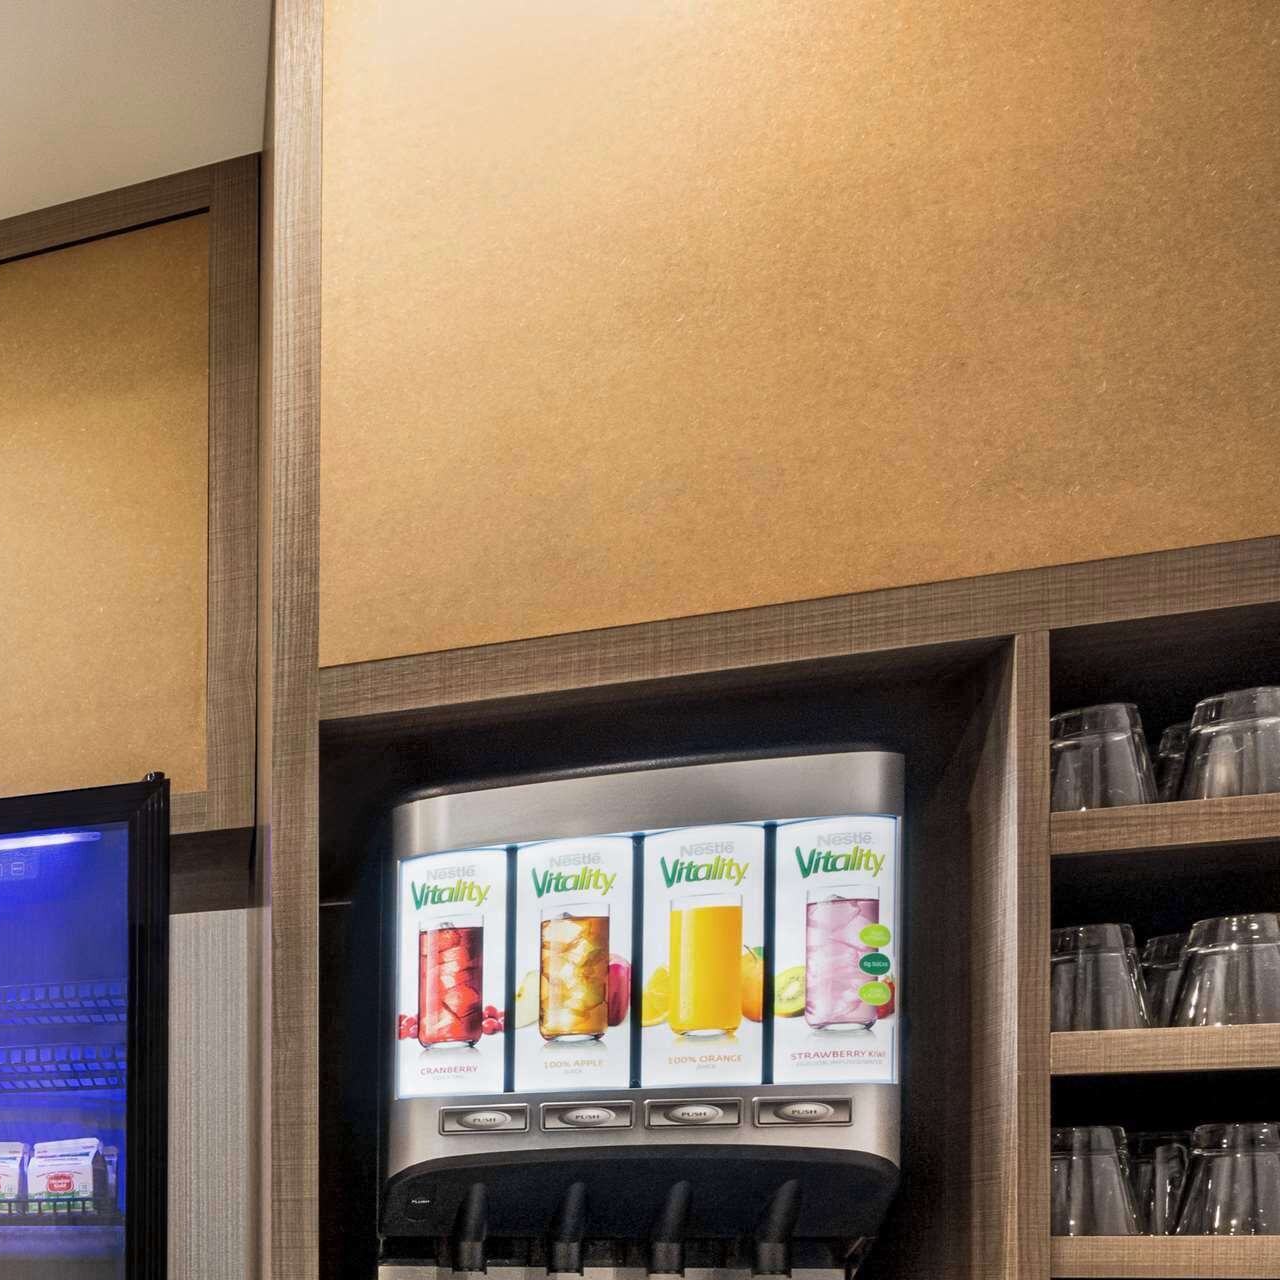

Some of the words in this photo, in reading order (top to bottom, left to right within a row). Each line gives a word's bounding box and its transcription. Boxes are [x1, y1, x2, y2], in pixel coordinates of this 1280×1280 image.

[660, 855, 750, 888] Vitality
[795, 845, 885, 879] Vitality
[532, 866, 616, 898] Vitality
[411, 879, 490, 910] Vitality
[544, 1060, 571, 1069] 100%
[574, 1059, 603, 1067] APPLE
[668, 1056, 697, 1064] 100%
[699, 1054, 743, 1063] ORANGE
[790, 1049, 866, 1060] STRAWBERRY
[420, 1065, 478, 1075] CRANBERRY
